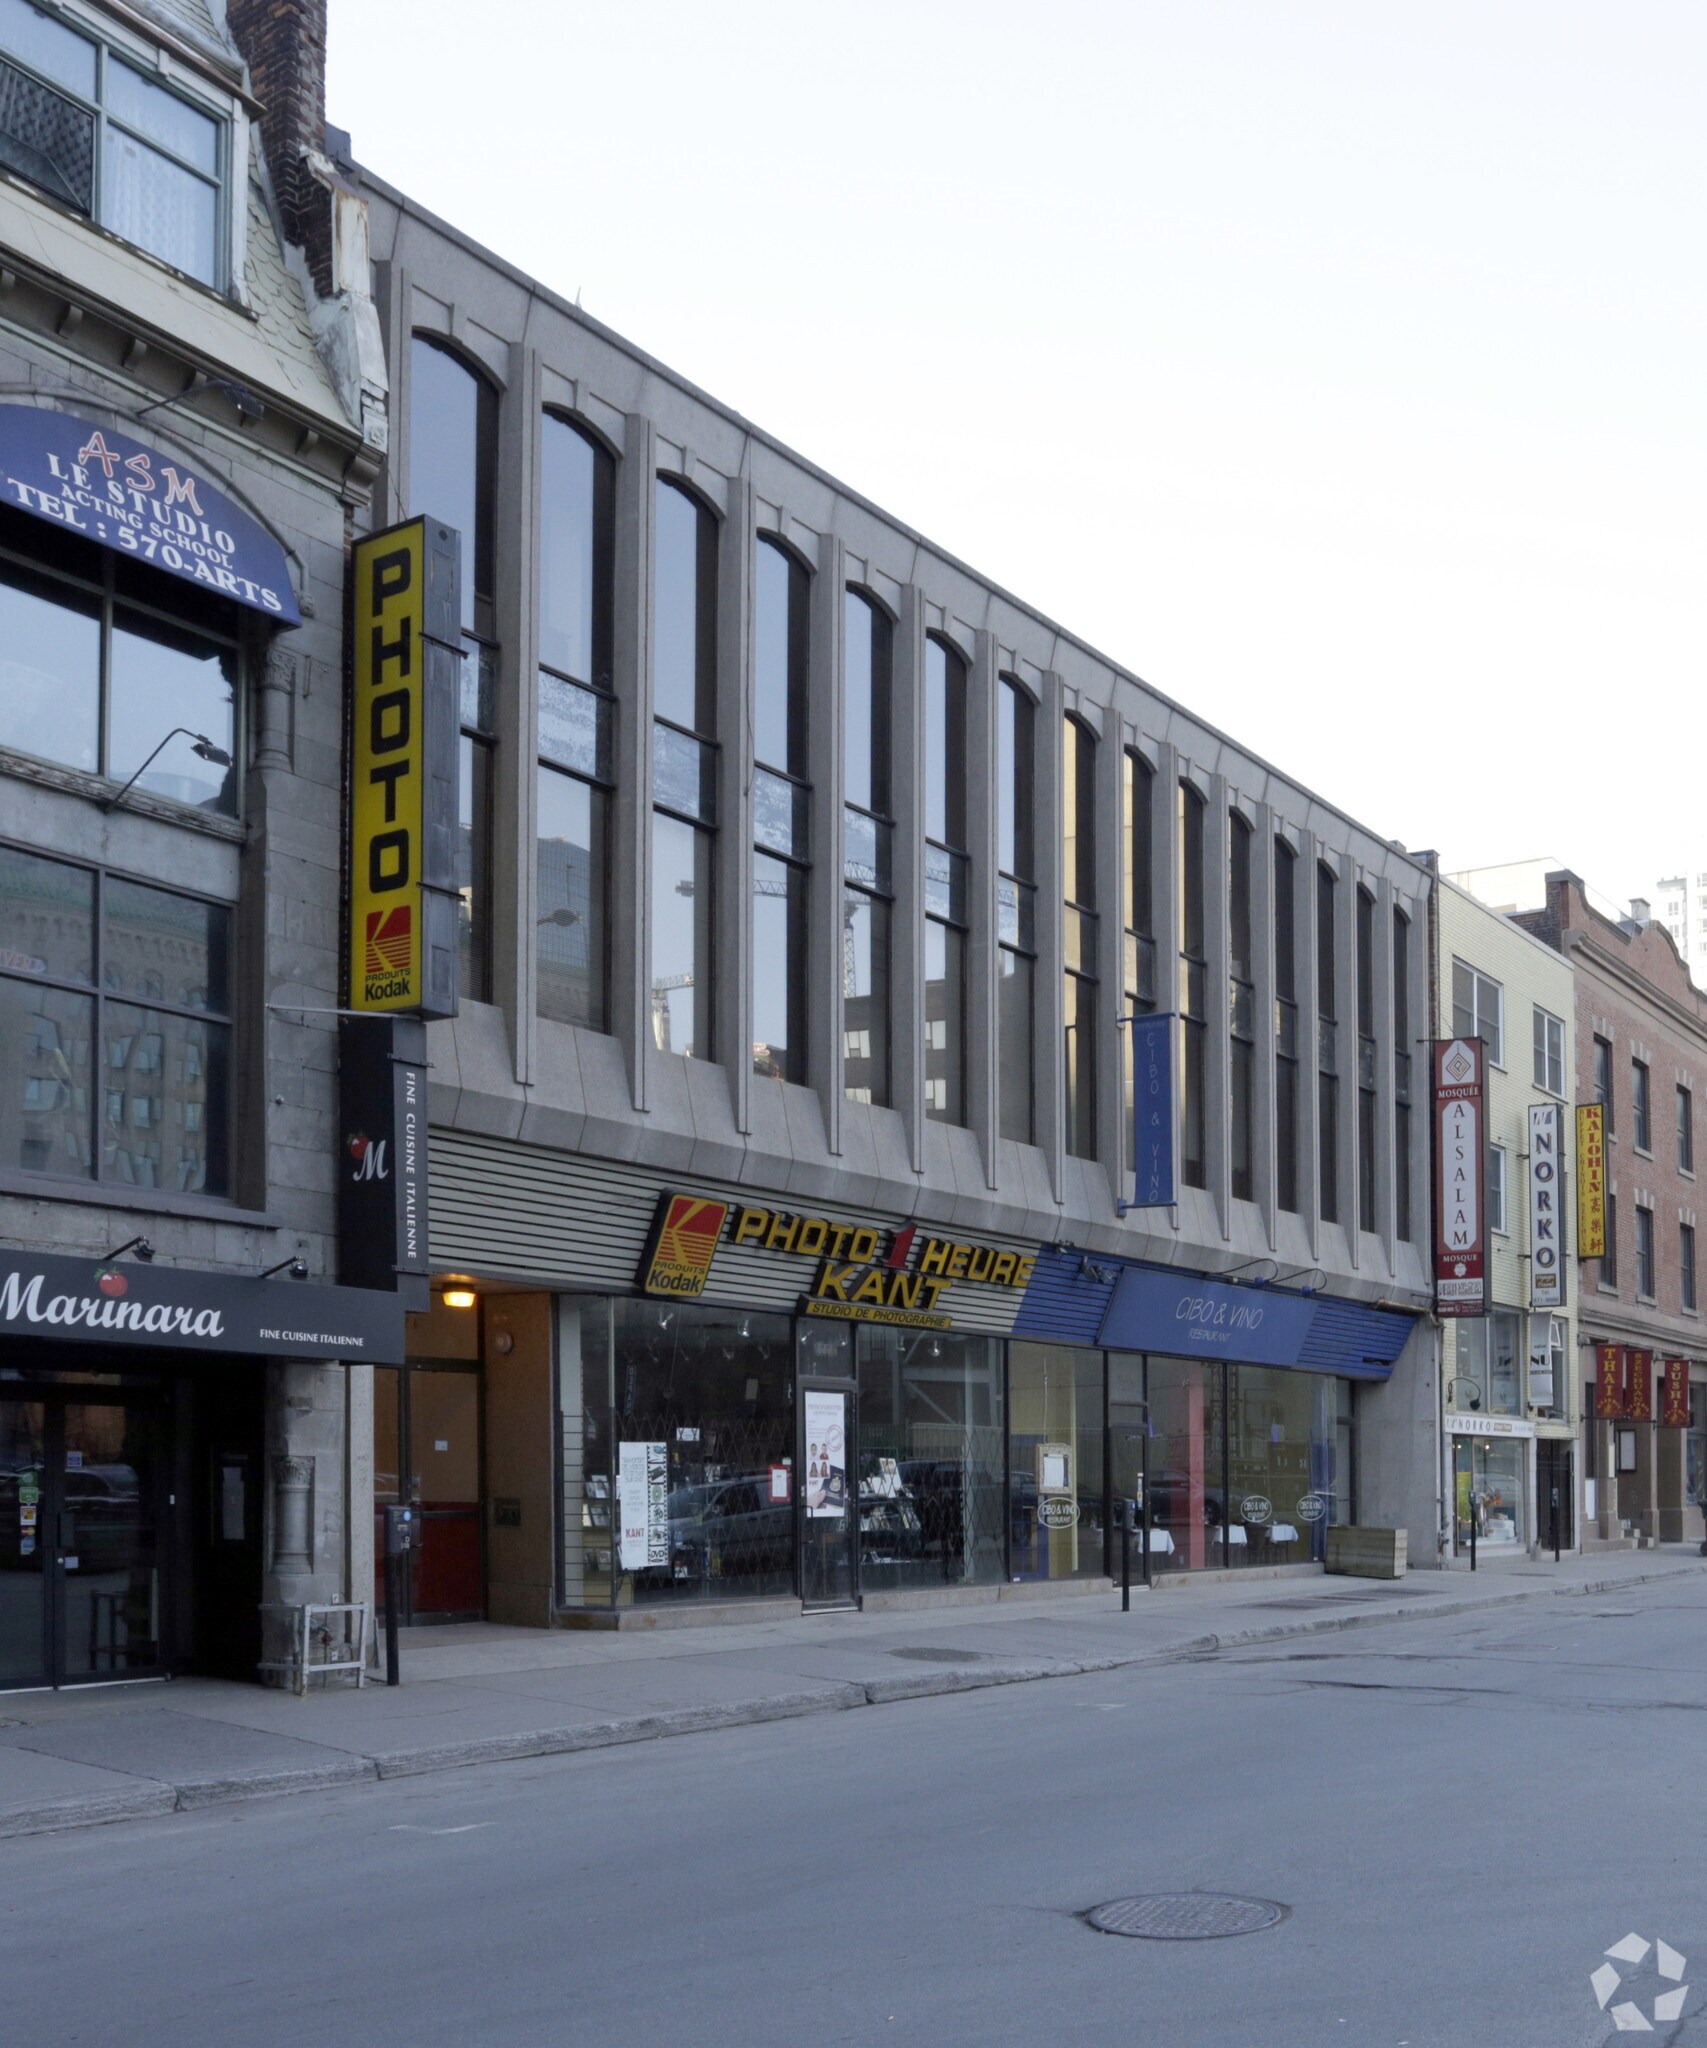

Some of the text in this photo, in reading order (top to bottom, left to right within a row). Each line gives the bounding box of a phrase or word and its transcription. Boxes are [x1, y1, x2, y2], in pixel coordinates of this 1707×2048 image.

[78, 431, 204, 516] ASM
[47, 452, 236, 554] LE STUDIO
[61, 483, 233, 569] ACTING SCHOOL
[7, 477, 87, 530] TEL
[118, 525, 282, 611] 570-ARTS
[369, 546, 411, 894] PHOTO
[365, 967, 411, 983] PRODUITS
[365, 977, 411, 1002] Kodak
[1438, 1084, 1479, 1099] MOSQUÉE
[1146, 1032, 1160, 1202] CIBO & VINO
[352, 1139, 389, 1181] M
[406, 1071, 417, 1259] FINE CUISINE ITALIENNE
[1586, 1107, 1601, 1192] KALOHIN
[1535, 1133, 1555, 1268] NORKO
[653, 1260, 706, 1275] PRODUITS
[733, 1206, 1038, 1288] PHOTO 1 HEURE
[1443, 1253, 1478, 1262] MOSQUE
[0, 1271, 225, 1338] Marinara
[648, 1269, 702, 1293] Kodak
[817, 1263, 953, 1311] KANT
[812, 1303, 946, 1328] STUDIO DE PHOTOGRAPHIE
[1175, 1296, 1263, 1329] CIBO & VINO
[259, 1328, 364, 1347] FINE CUISINE ITALIENNE
[1604, 1347, 1616, 1396] THAI
[1670, 1362, 1682, 1408] SUSHI
[1458, 1419, 1491, 1432] NORKO
[625, 1528, 645, 1538] KANT
